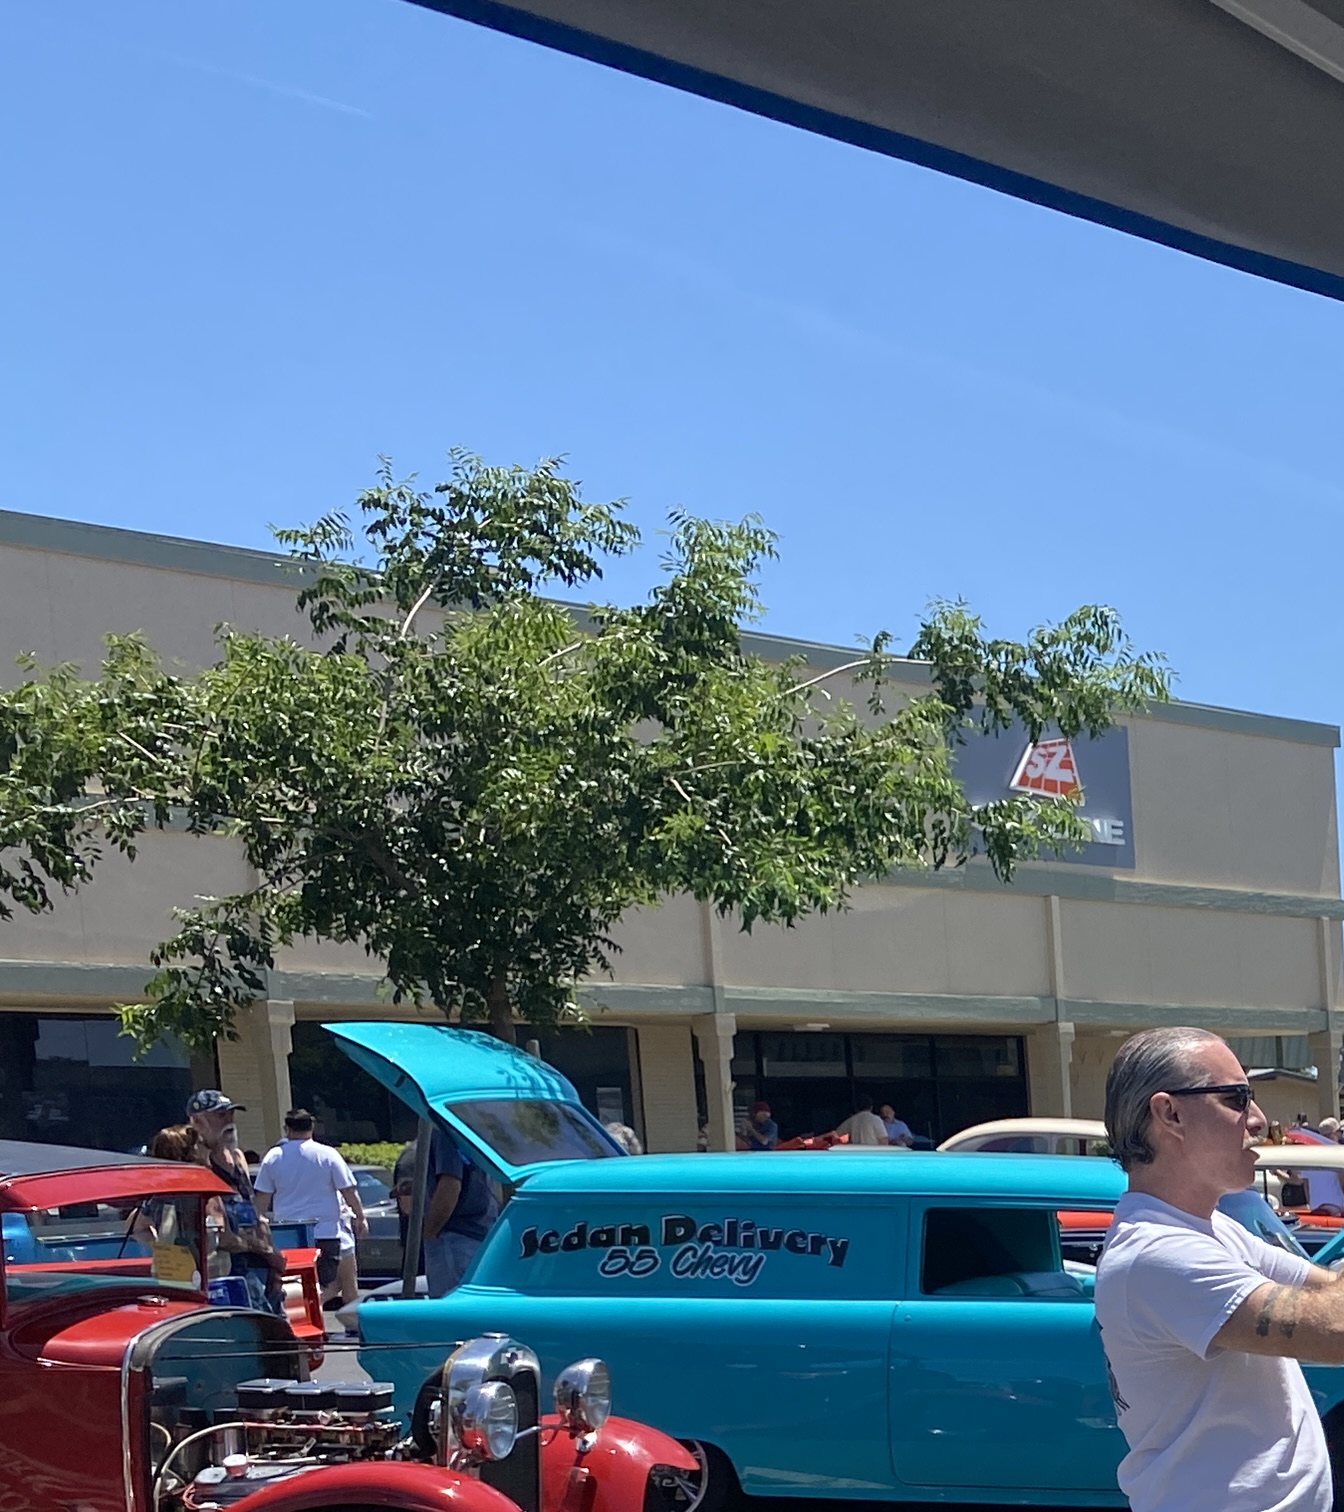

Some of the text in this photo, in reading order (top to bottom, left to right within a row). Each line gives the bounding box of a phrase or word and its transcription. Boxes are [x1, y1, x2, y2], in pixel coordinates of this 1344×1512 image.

[1026, 745, 1074, 784] SZ
[518, 1213, 849, 1268] Sedan Delivery
[597, 1242, 766, 1287] 55 Chevy
